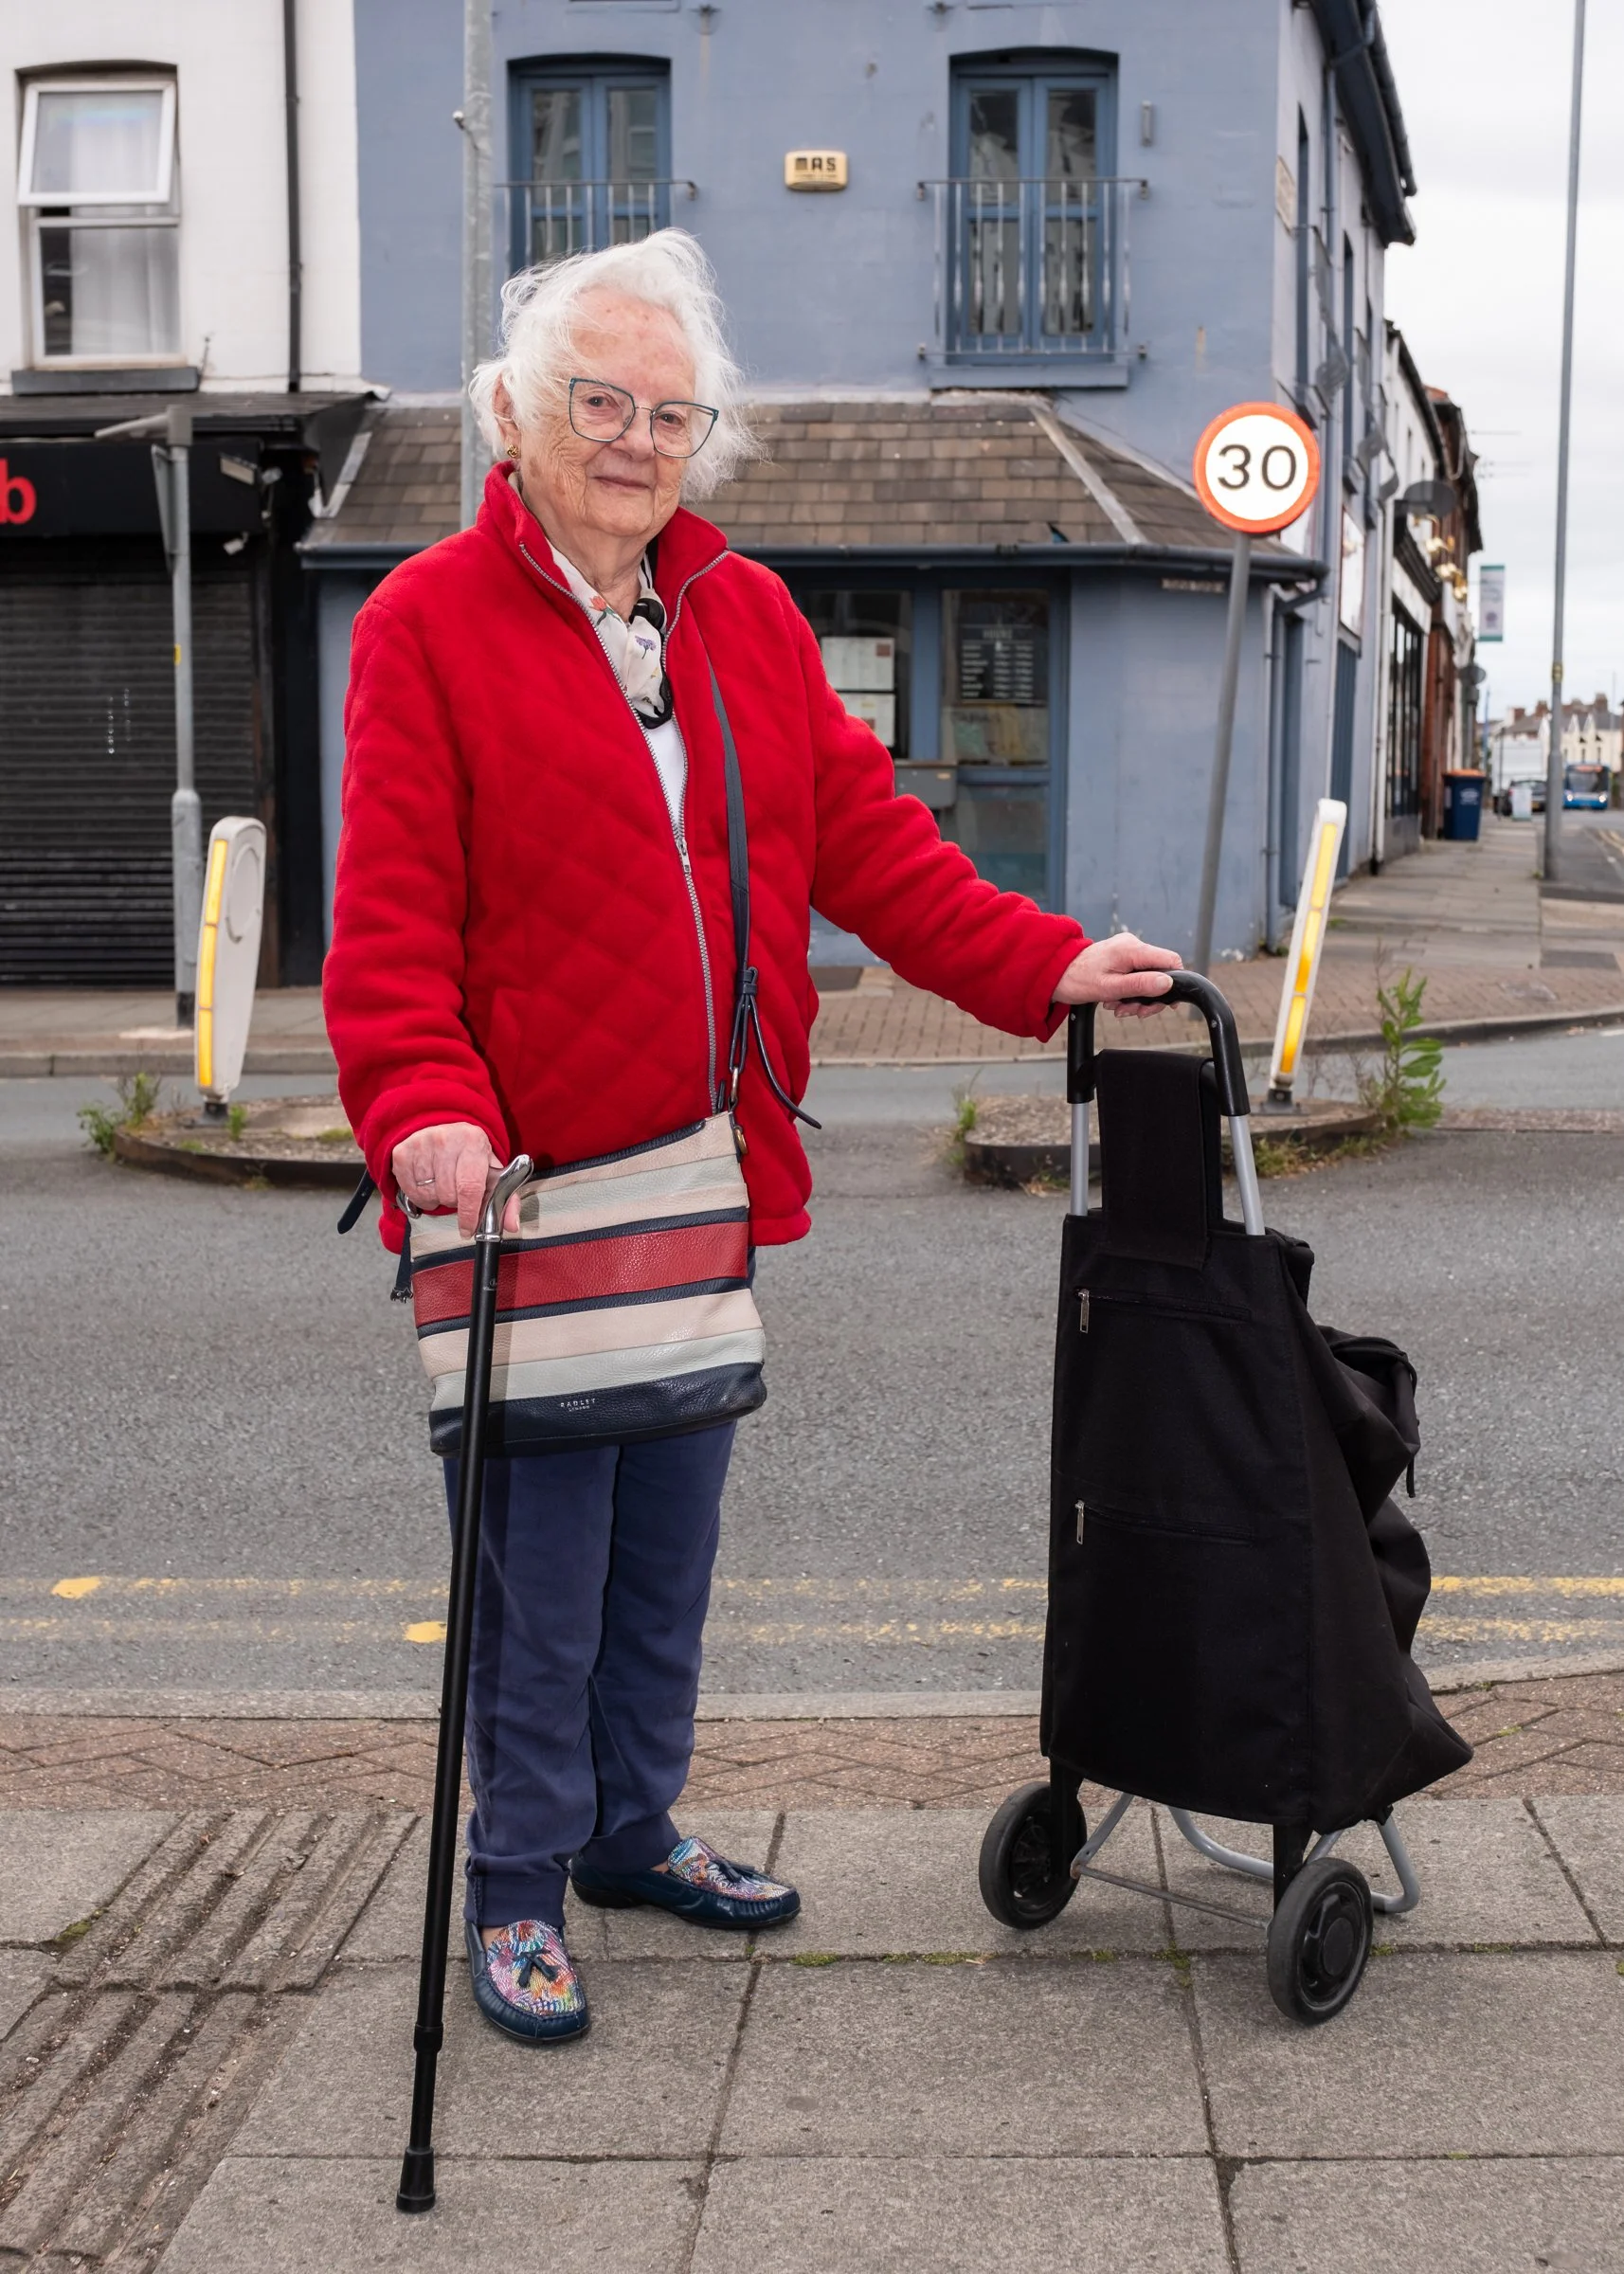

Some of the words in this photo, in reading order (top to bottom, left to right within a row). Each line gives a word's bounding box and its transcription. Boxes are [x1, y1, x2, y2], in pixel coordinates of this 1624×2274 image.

[1218, 444, 1296, 490] 30
[0, 459, 37, 524] b
[560, 1398, 596, 1408] RADLEY
